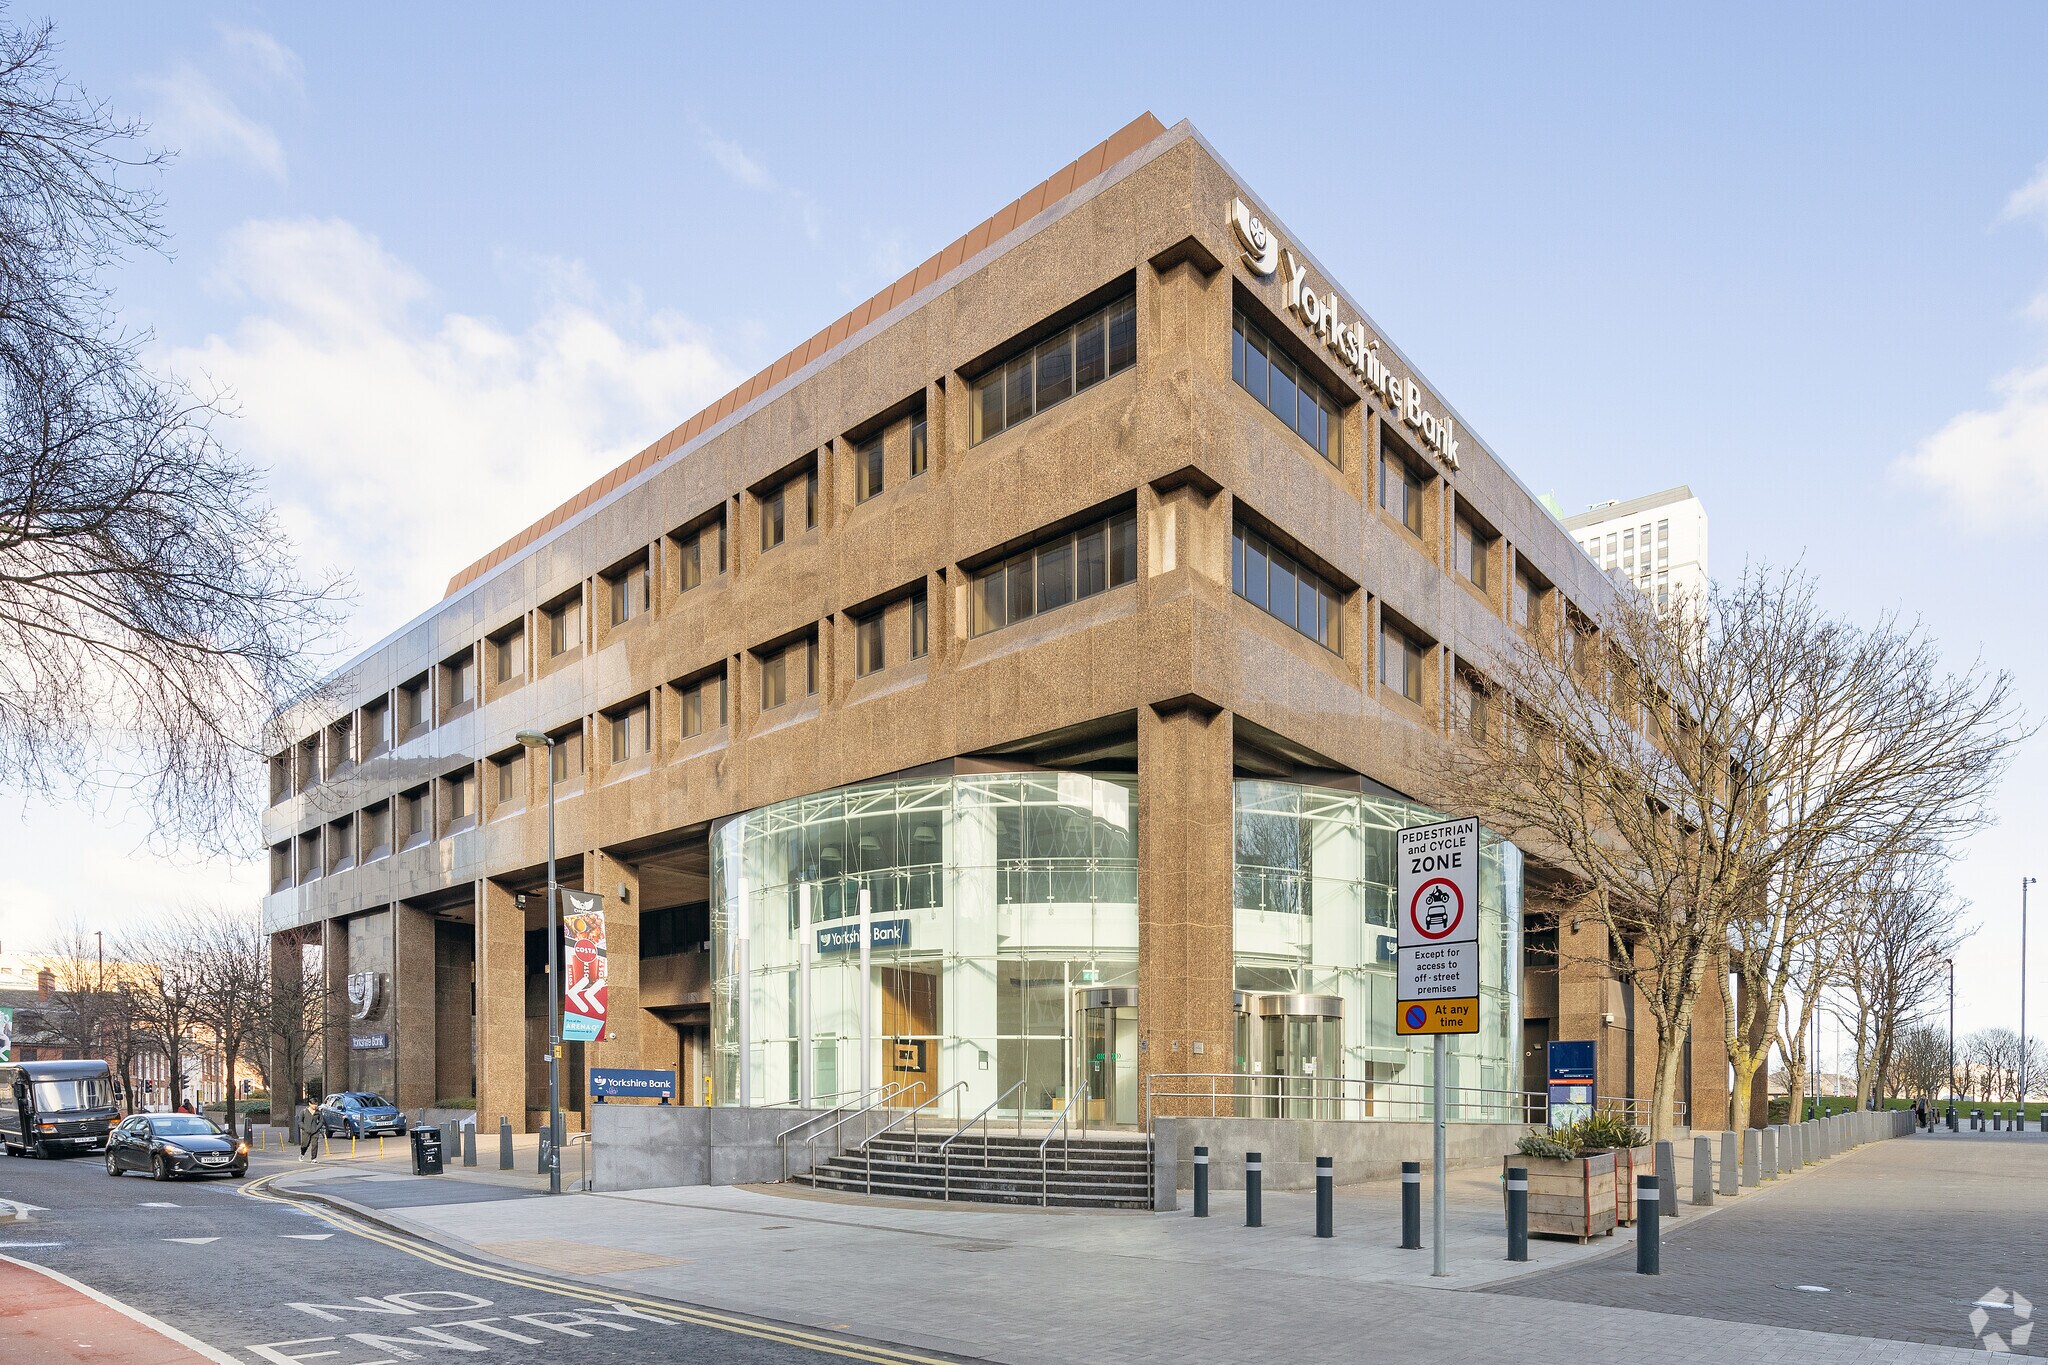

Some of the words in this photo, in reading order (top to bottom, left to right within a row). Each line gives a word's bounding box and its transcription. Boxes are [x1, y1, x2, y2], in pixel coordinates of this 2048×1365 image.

[1283, 248, 1402, 409] Yorkshire
[1400, 376, 1459, 472] Bank
[1402, 823, 1473, 843] PEDESTRIAN
[1408, 843, 1426, 854] and
[1430, 837, 1466, 851] CYCLE
[1412, 852, 1462, 874] ZONE
[874, 926, 900, 940] Bank
[1415, 950, 1444, 960] Except
[1448, 948, 1460, 956] for
[1417, 962, 1446, 970] access
[1448, 960, 1458, 968] to
[1418, 984, 1456, 995] premises
[1435, 1004, 1447, 1014] At
[1450, 1006, 1468, 1016] any
[1440, 1018, 1464, 1026] time
[608, 1078, 647, 1087] Yorkshire
[649, 1080, 671, 1088] Bank
[284, 1290, 494, 1322] NO
[244, 1303, 681, 1365] ENTRY
